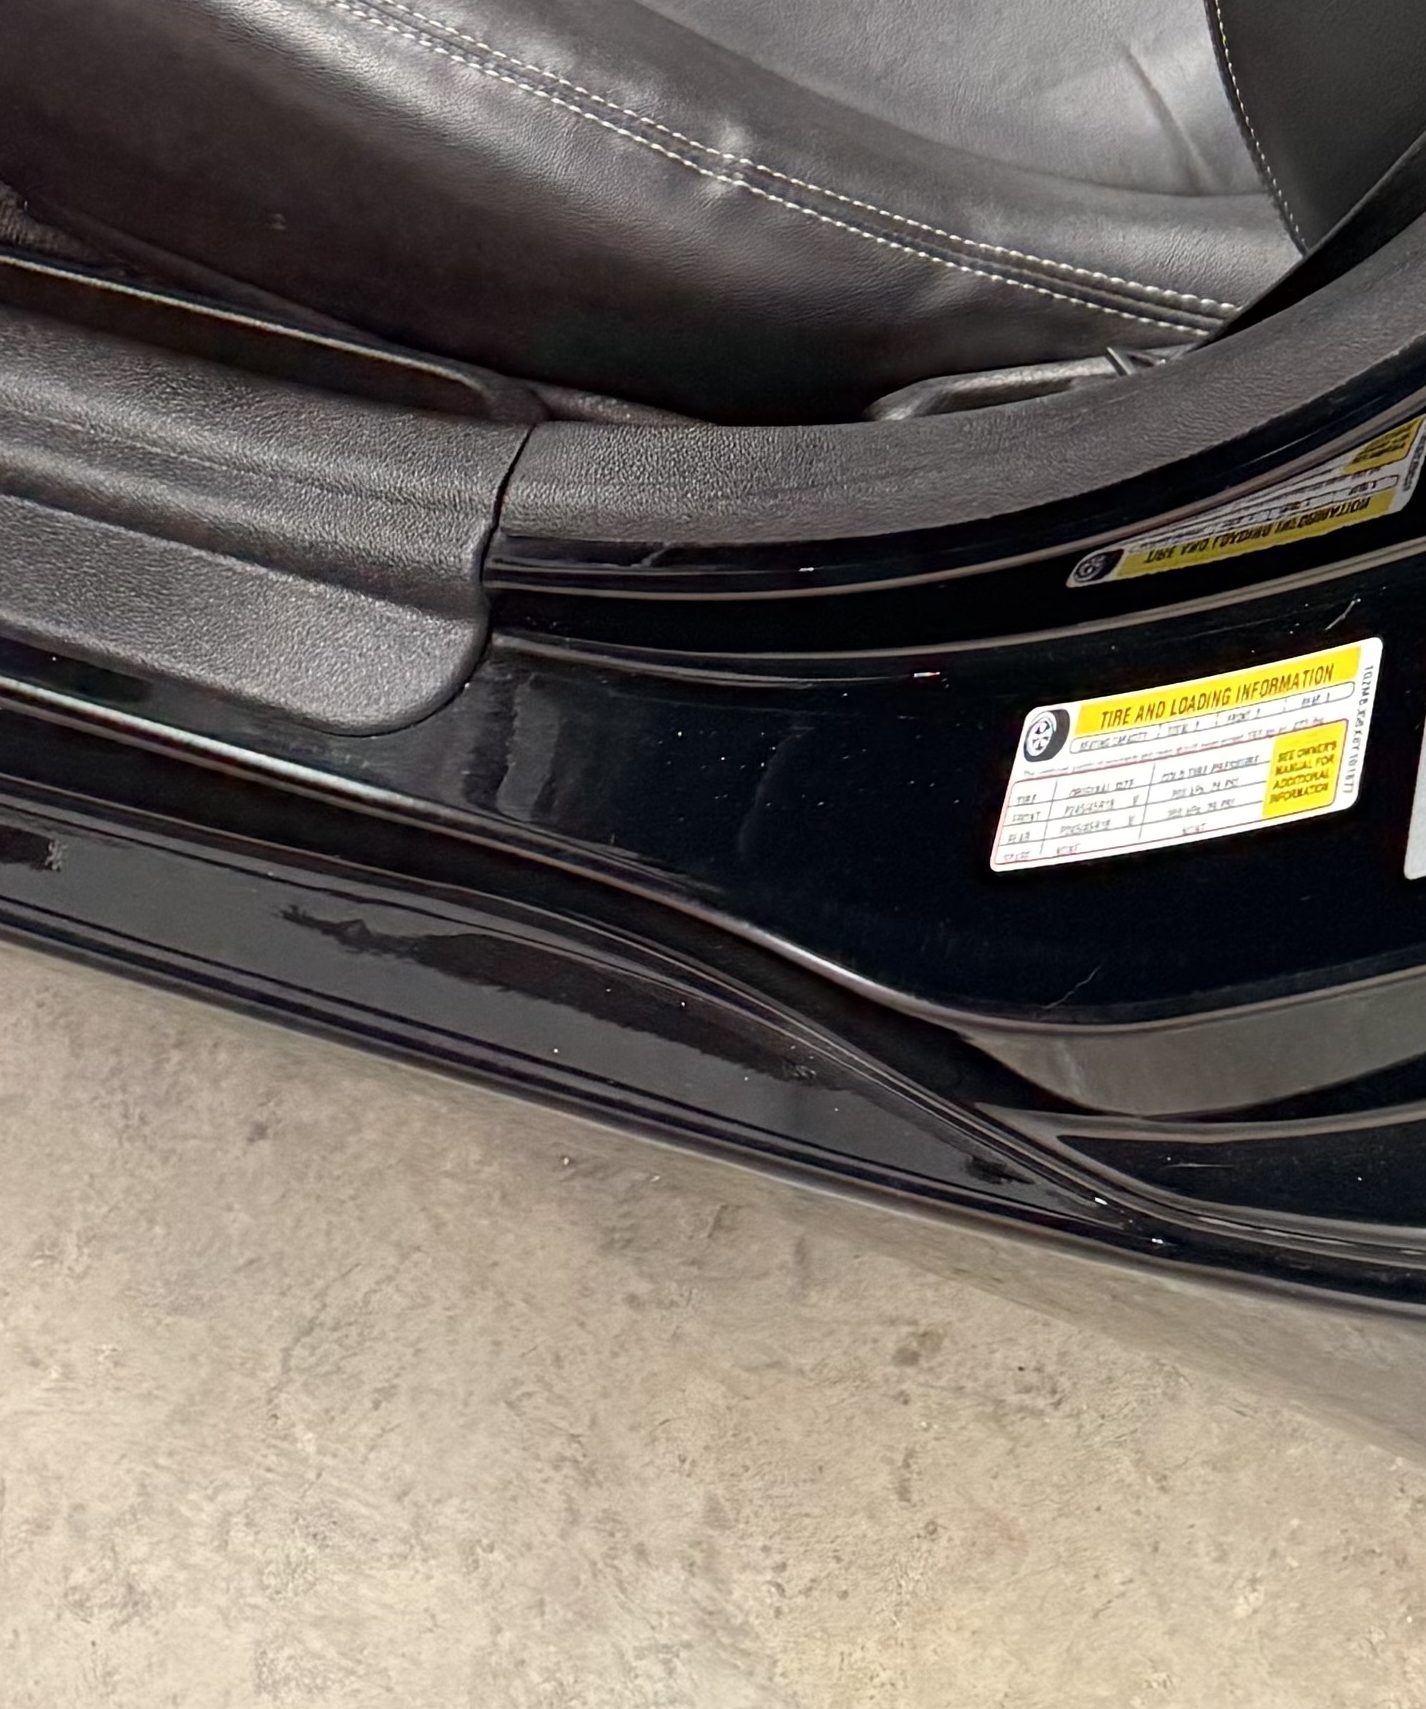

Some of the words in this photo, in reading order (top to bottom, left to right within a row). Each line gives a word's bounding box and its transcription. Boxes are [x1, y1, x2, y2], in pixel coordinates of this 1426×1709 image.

[1098, 705, 1132, 730] TIRE
[1133, 700, 1166, 723] AND
[1169, 686, 1232, 716] LOADING
[1235, 663, 1334, 703] INFORMATION
[1315, 754, 1335, 767] FOR
